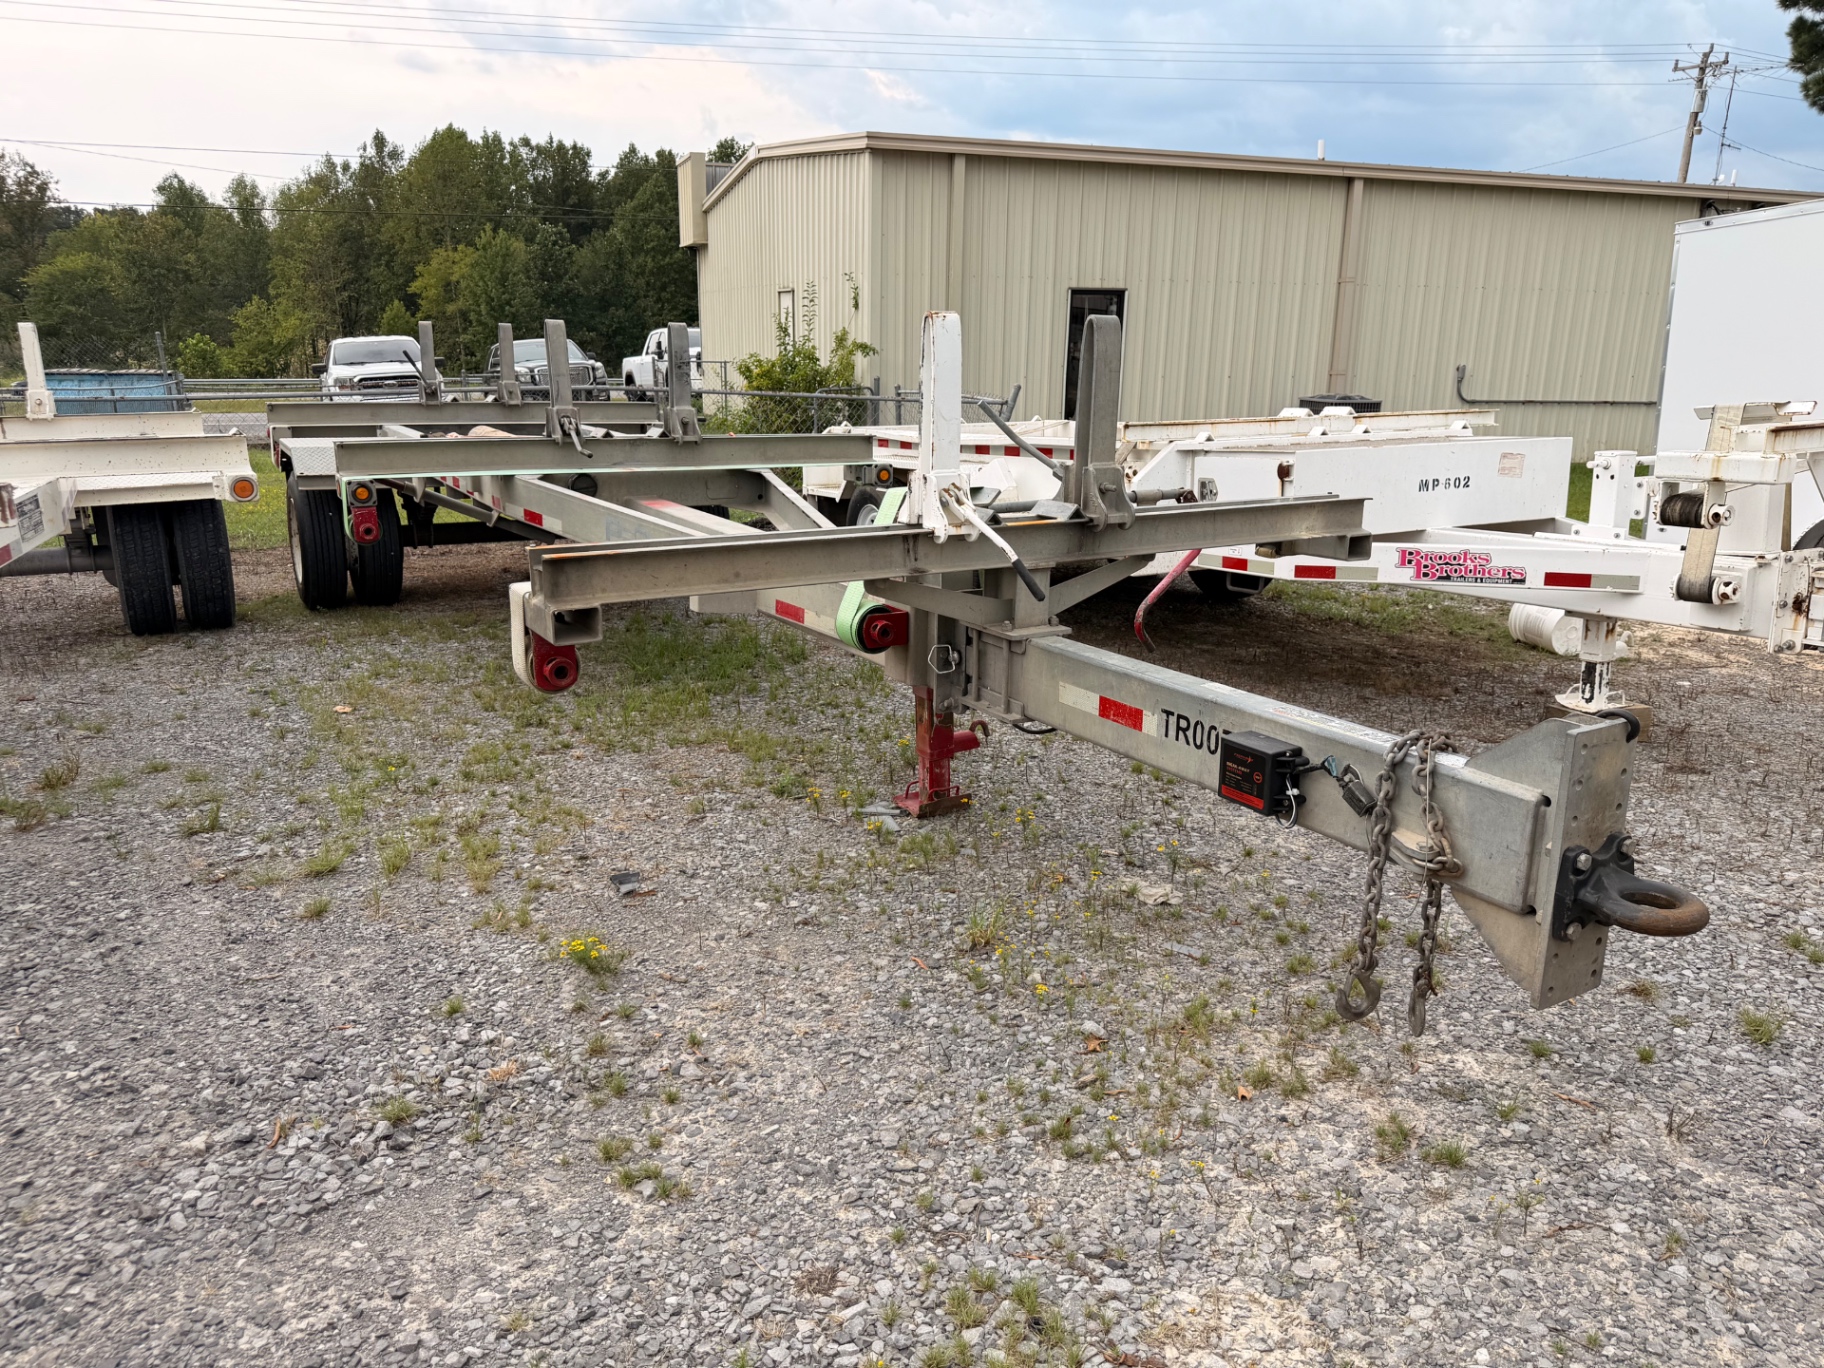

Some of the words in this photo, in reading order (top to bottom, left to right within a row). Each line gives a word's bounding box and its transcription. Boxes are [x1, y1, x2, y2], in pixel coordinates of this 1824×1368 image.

[1396, 547, 1491, 568] Brooks
[1410, 560, 1526, 580] Brothers
[1161, 708, 1232, 755] TR00
